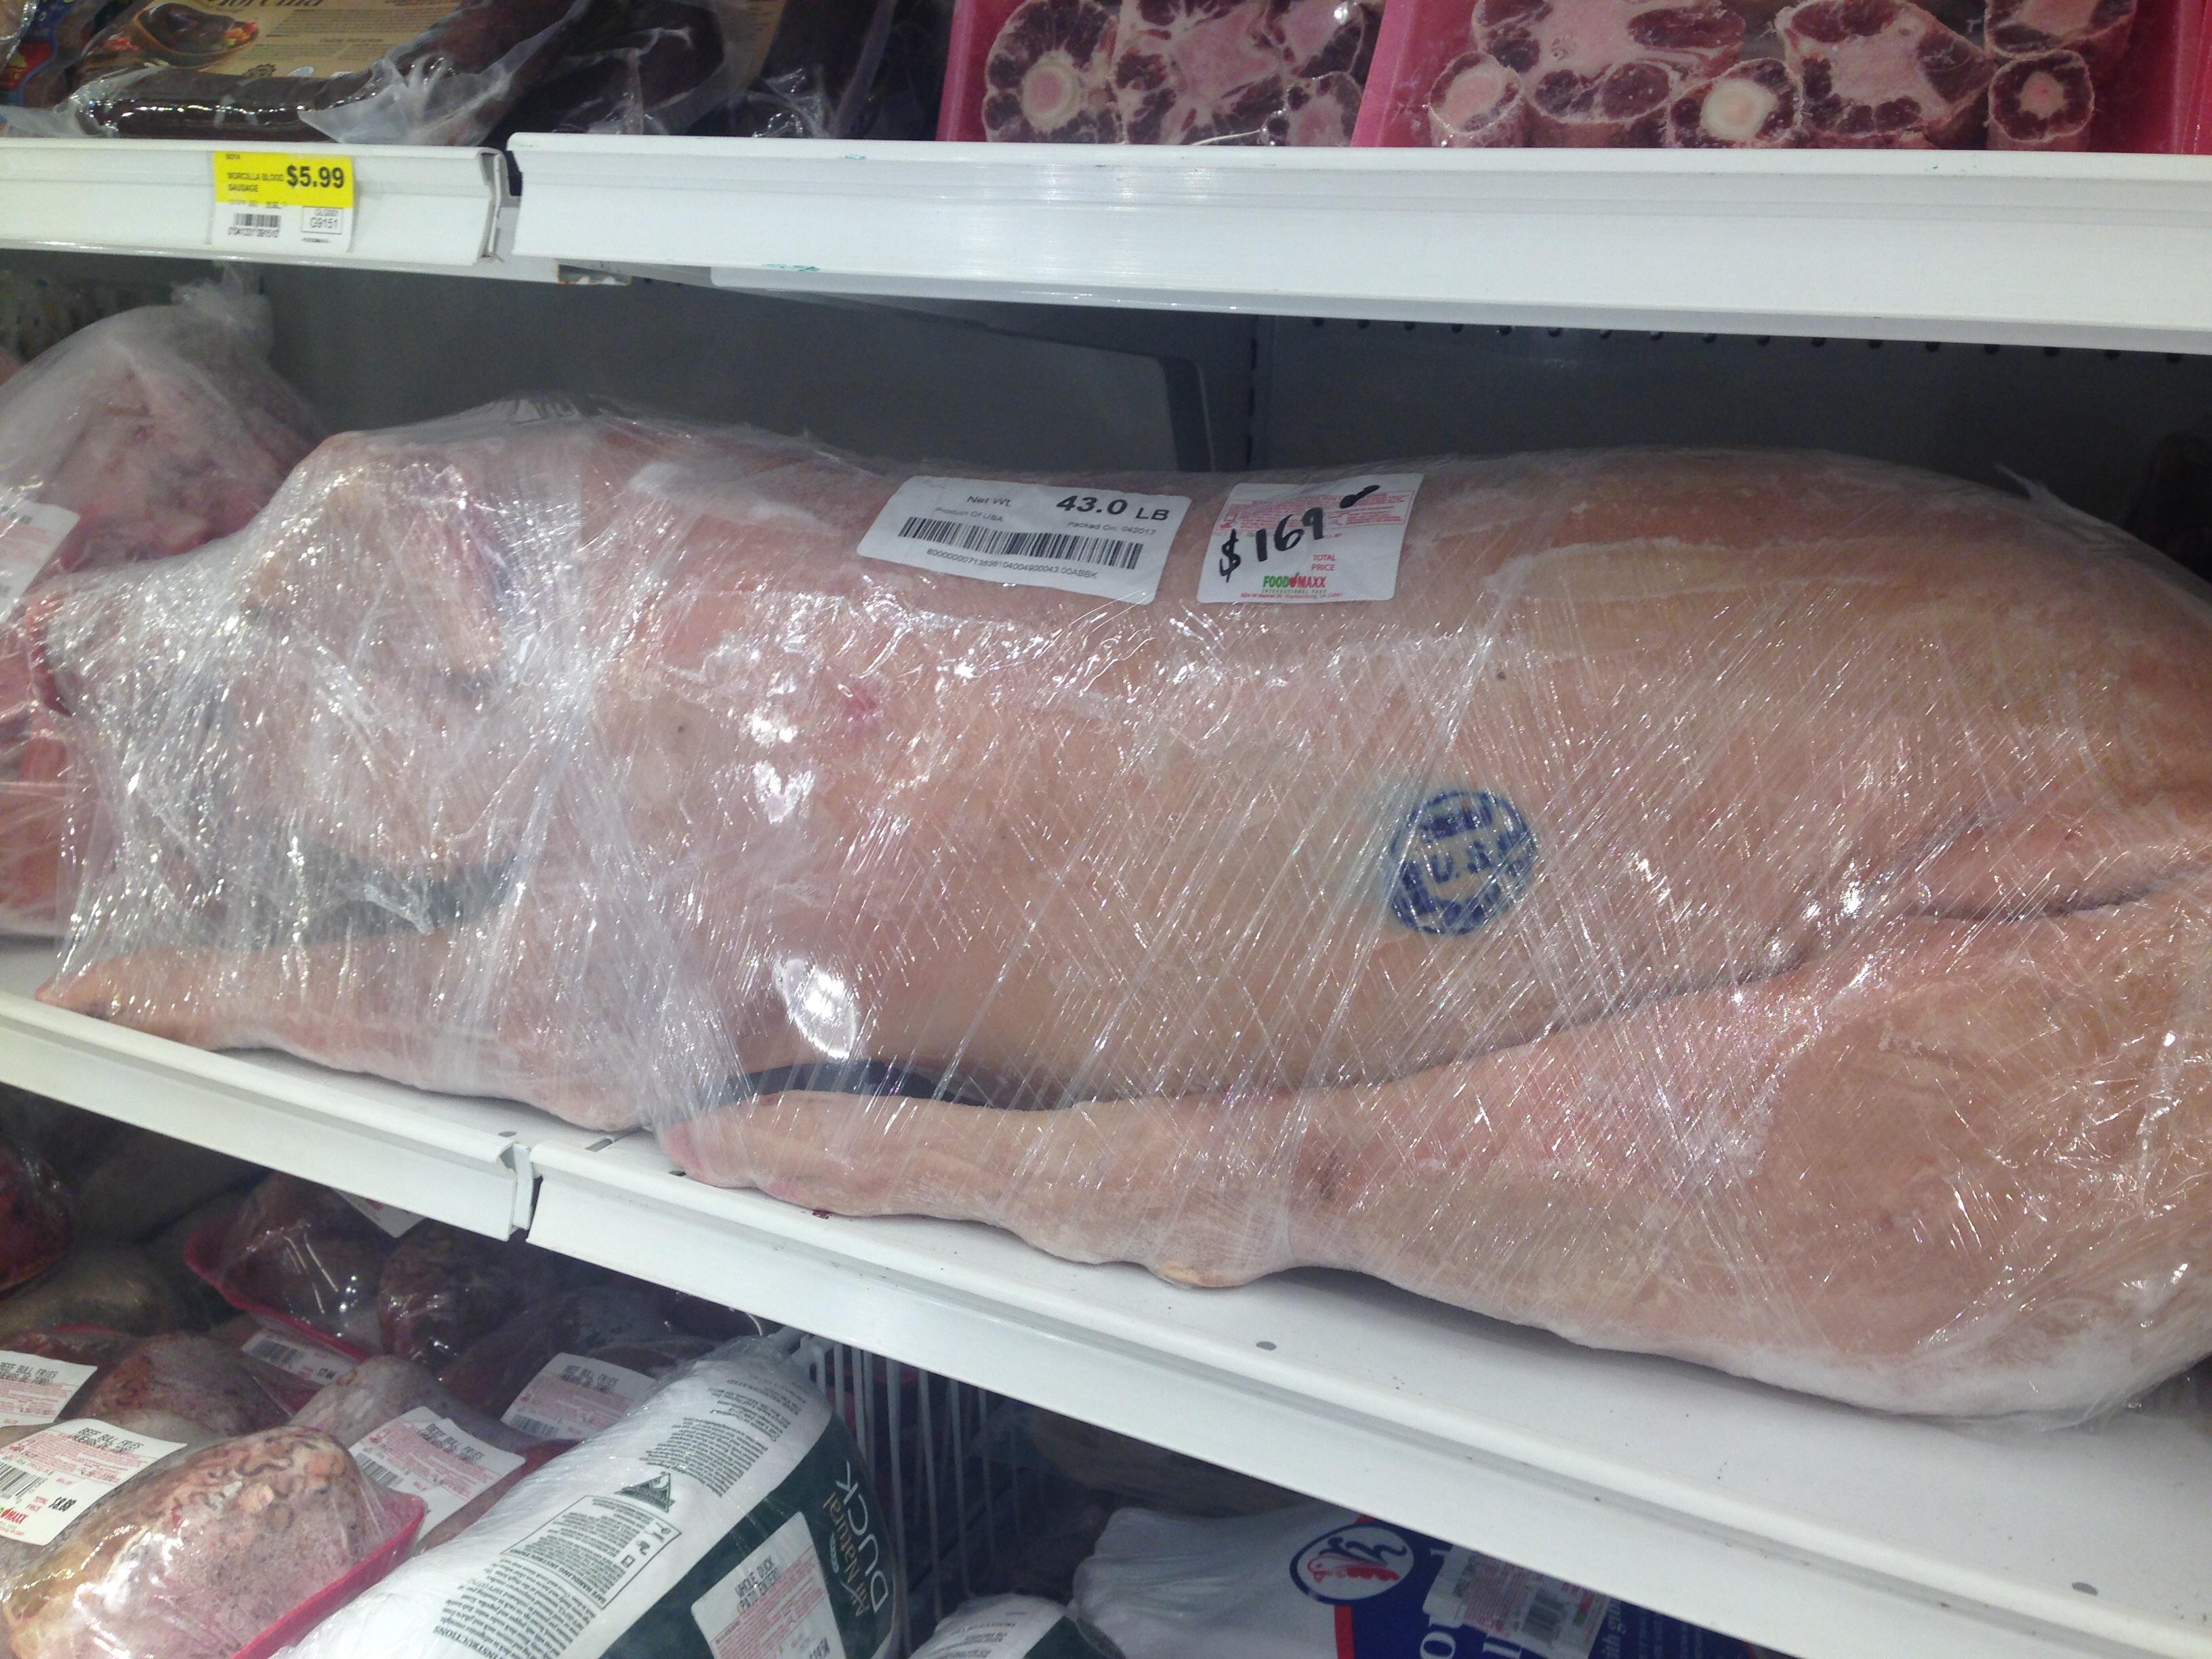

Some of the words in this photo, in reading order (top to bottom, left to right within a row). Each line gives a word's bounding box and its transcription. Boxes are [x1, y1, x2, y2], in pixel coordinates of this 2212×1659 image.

[287, 165, 345, 188] $5.99
[228, 184, 259, 192] SAUSAGE
[966, 495, 989, 504] Net
[1056, 495, 1128, 515] 43.0
[1135, 507, 1170, 520] LB
[935, 507, 969, 516] Product
[983, 512, 1004, 522] USA
[1067, 521, 1101, 530] Packed
[1311, 563, 1335, 571] PRICE
[35, 1368, 59, 1379] FRIES
[822, 1491, 861, 1584] Natural
[836, 1459, 889, 1614] DUCK
[509, 1547, 558, 1570] INSTRUCTIONS
[558, 1566, 592, 1593] HANDLING
[591, 1590, 607, 1605] SAFE
[432, 1624, 498, 1659] INSTRUCTIONS
